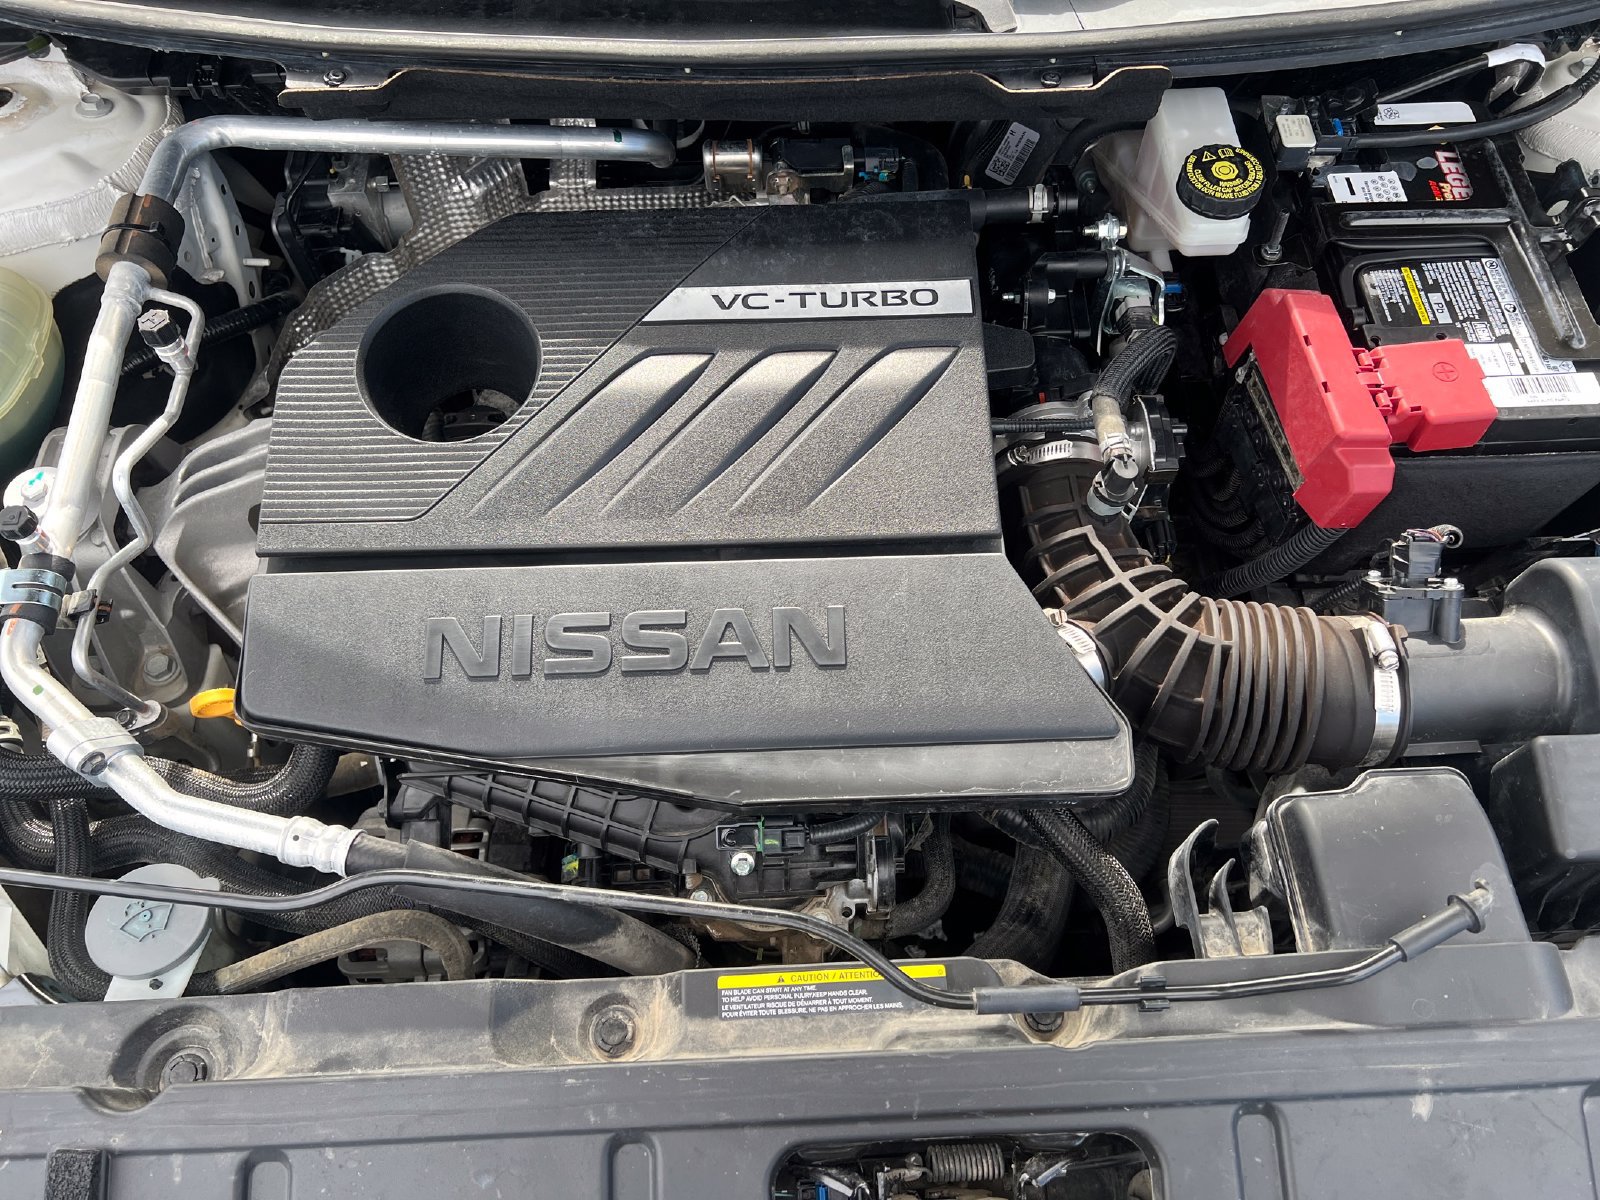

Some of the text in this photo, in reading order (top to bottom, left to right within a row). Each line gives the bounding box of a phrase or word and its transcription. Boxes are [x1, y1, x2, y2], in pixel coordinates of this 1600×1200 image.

[1434, 150, 1474, 201] LEGE
[711, 288, 939, 311] VC-TURBO
[1434, 302, 1445, 314] Pb
[424, 606, 847, 679] NISSAN
[791, 973, 829, 982] CAUTION
[839, 970, 880, 979] ATTENTIO
[746, 994, 762, 1002] AVOID
[729, 1002, 765, 1010] VENTILATEUR
[759, 1008, 776, 1016] TOUTE
